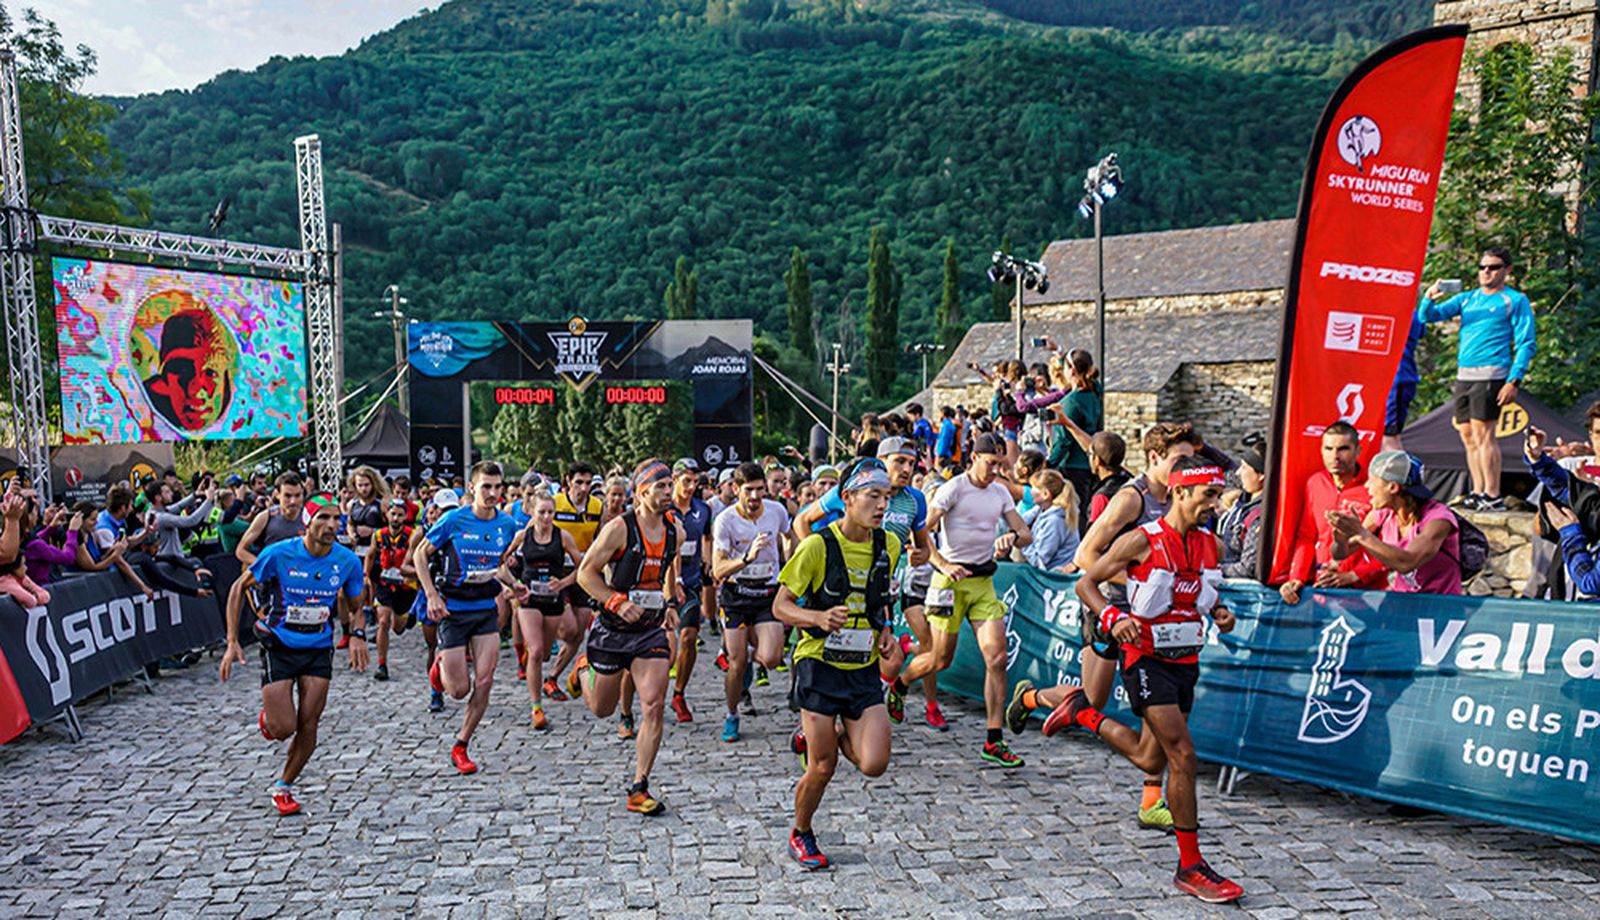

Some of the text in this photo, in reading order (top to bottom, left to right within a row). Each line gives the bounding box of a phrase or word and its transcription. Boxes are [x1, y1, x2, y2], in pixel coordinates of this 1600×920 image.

[1370, 164, 1430, 184] MIGU RUN
[1328, 173, 1414, 196] SKYRUNNER
[1351, 192, 1424, 213] WORLD SERIES
[1320, 262, 1415, 286] PROZIS
[557, 337, 599, 355] EPIC
[557, 355, 598, 364] TRAIL
[692, 365, 746, 374] JOAN ROJAS
[705, 356, 747, 365] MEMORIAL
[495, 387, 554, 404] 00:00:04
[606, 387, 665, 403] 00:00:00
[1501, 408, 1522, 431] FF
[62, 590, 182, 664] SCOTT
[1054, 642, 1074, 661] On
[1417, 618, 1554, 675] Vall
[1451, 696, 1496, 726] On
[1506, 704, 1562, 734] els
[1462, 738, 1589, 783] toquen
